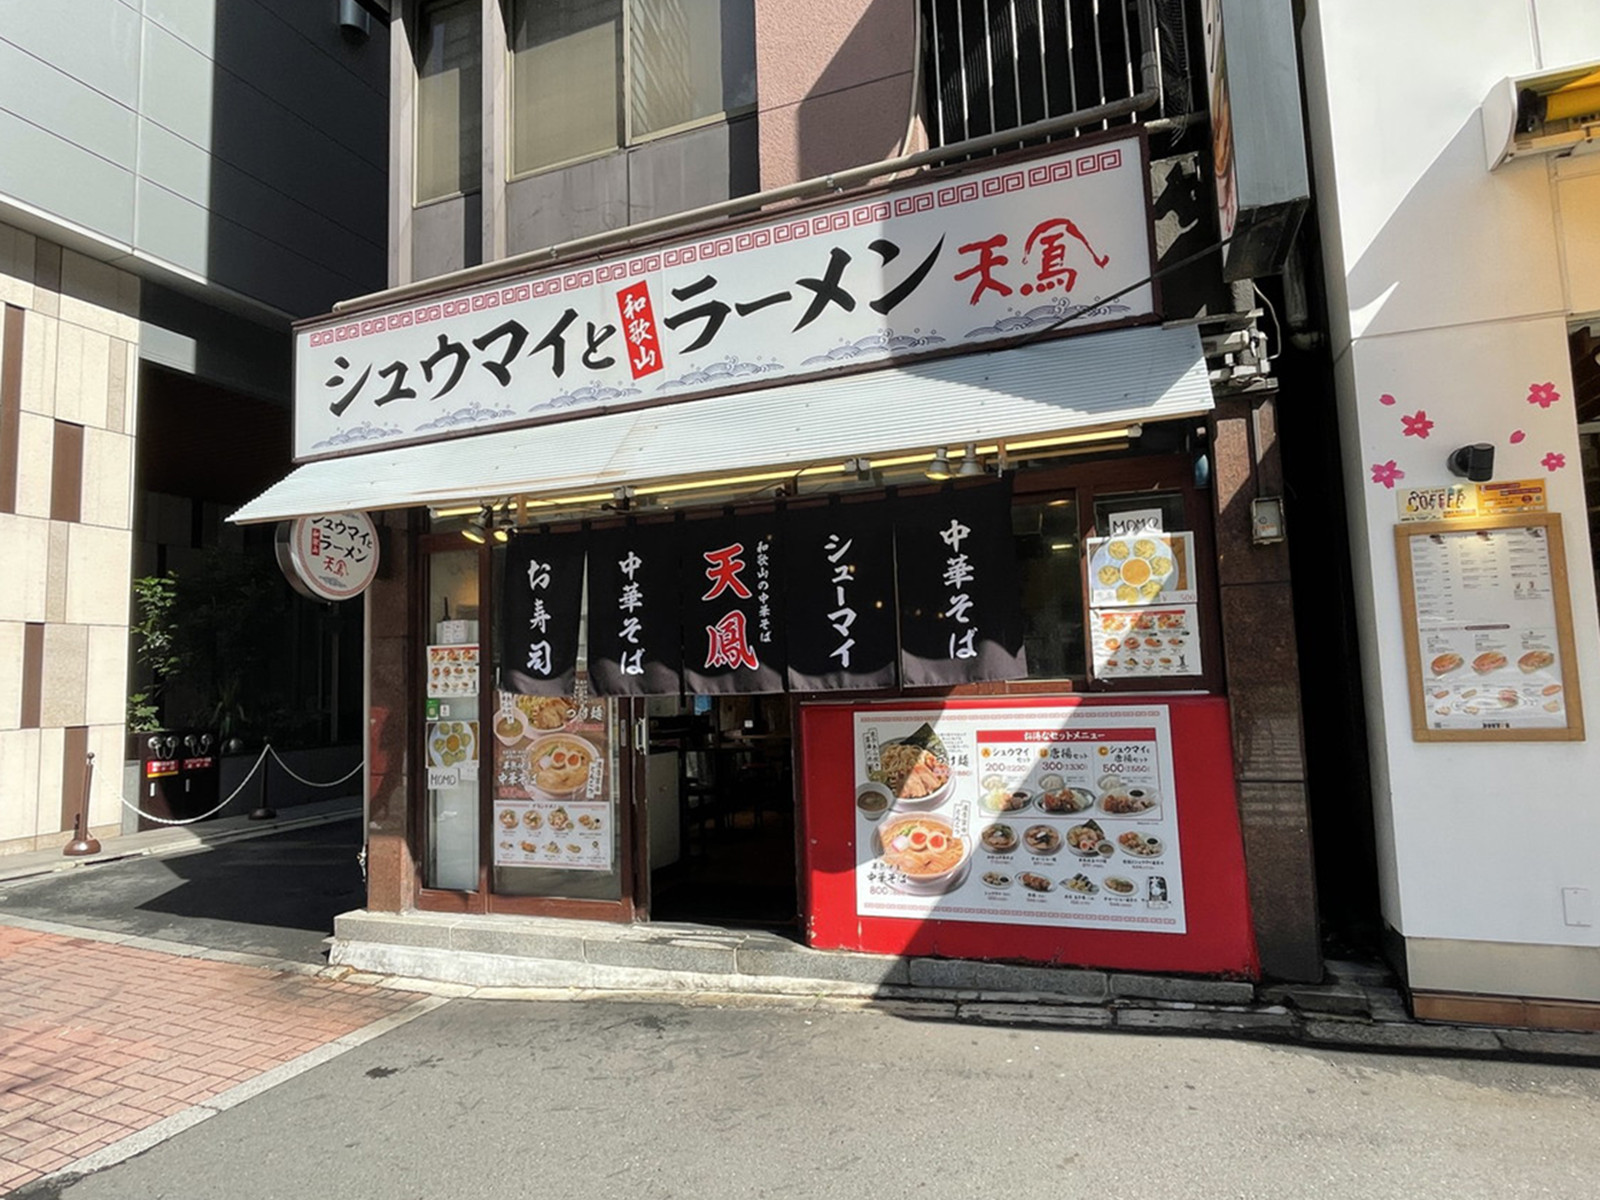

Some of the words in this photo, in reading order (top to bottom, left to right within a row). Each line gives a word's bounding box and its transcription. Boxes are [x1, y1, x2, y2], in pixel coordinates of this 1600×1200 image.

[953, 217, 1109, 306] 天鳳
[326, 304, 616, 417] シュウマイと
[620, 293, 660, 374] 和歌山
[663, 232, 946, 355] ラーメン
[320, 533, 369, 563] ラーメン
[939, 519, 979, 660] 中華そば
[526, 559, 552, 676] お寿司
[617, 551, 646, 676] 中華そば
[701, 542, 760, 671] 天鳳
[824, 534, 858, 668] シューマイ
[985, 763, 1005, 772] 200
[992, 748, 1030, 758] シュウマイ
[1042, 762, 1063, 771] 300
[1102, 763, 1124, 773] 500
